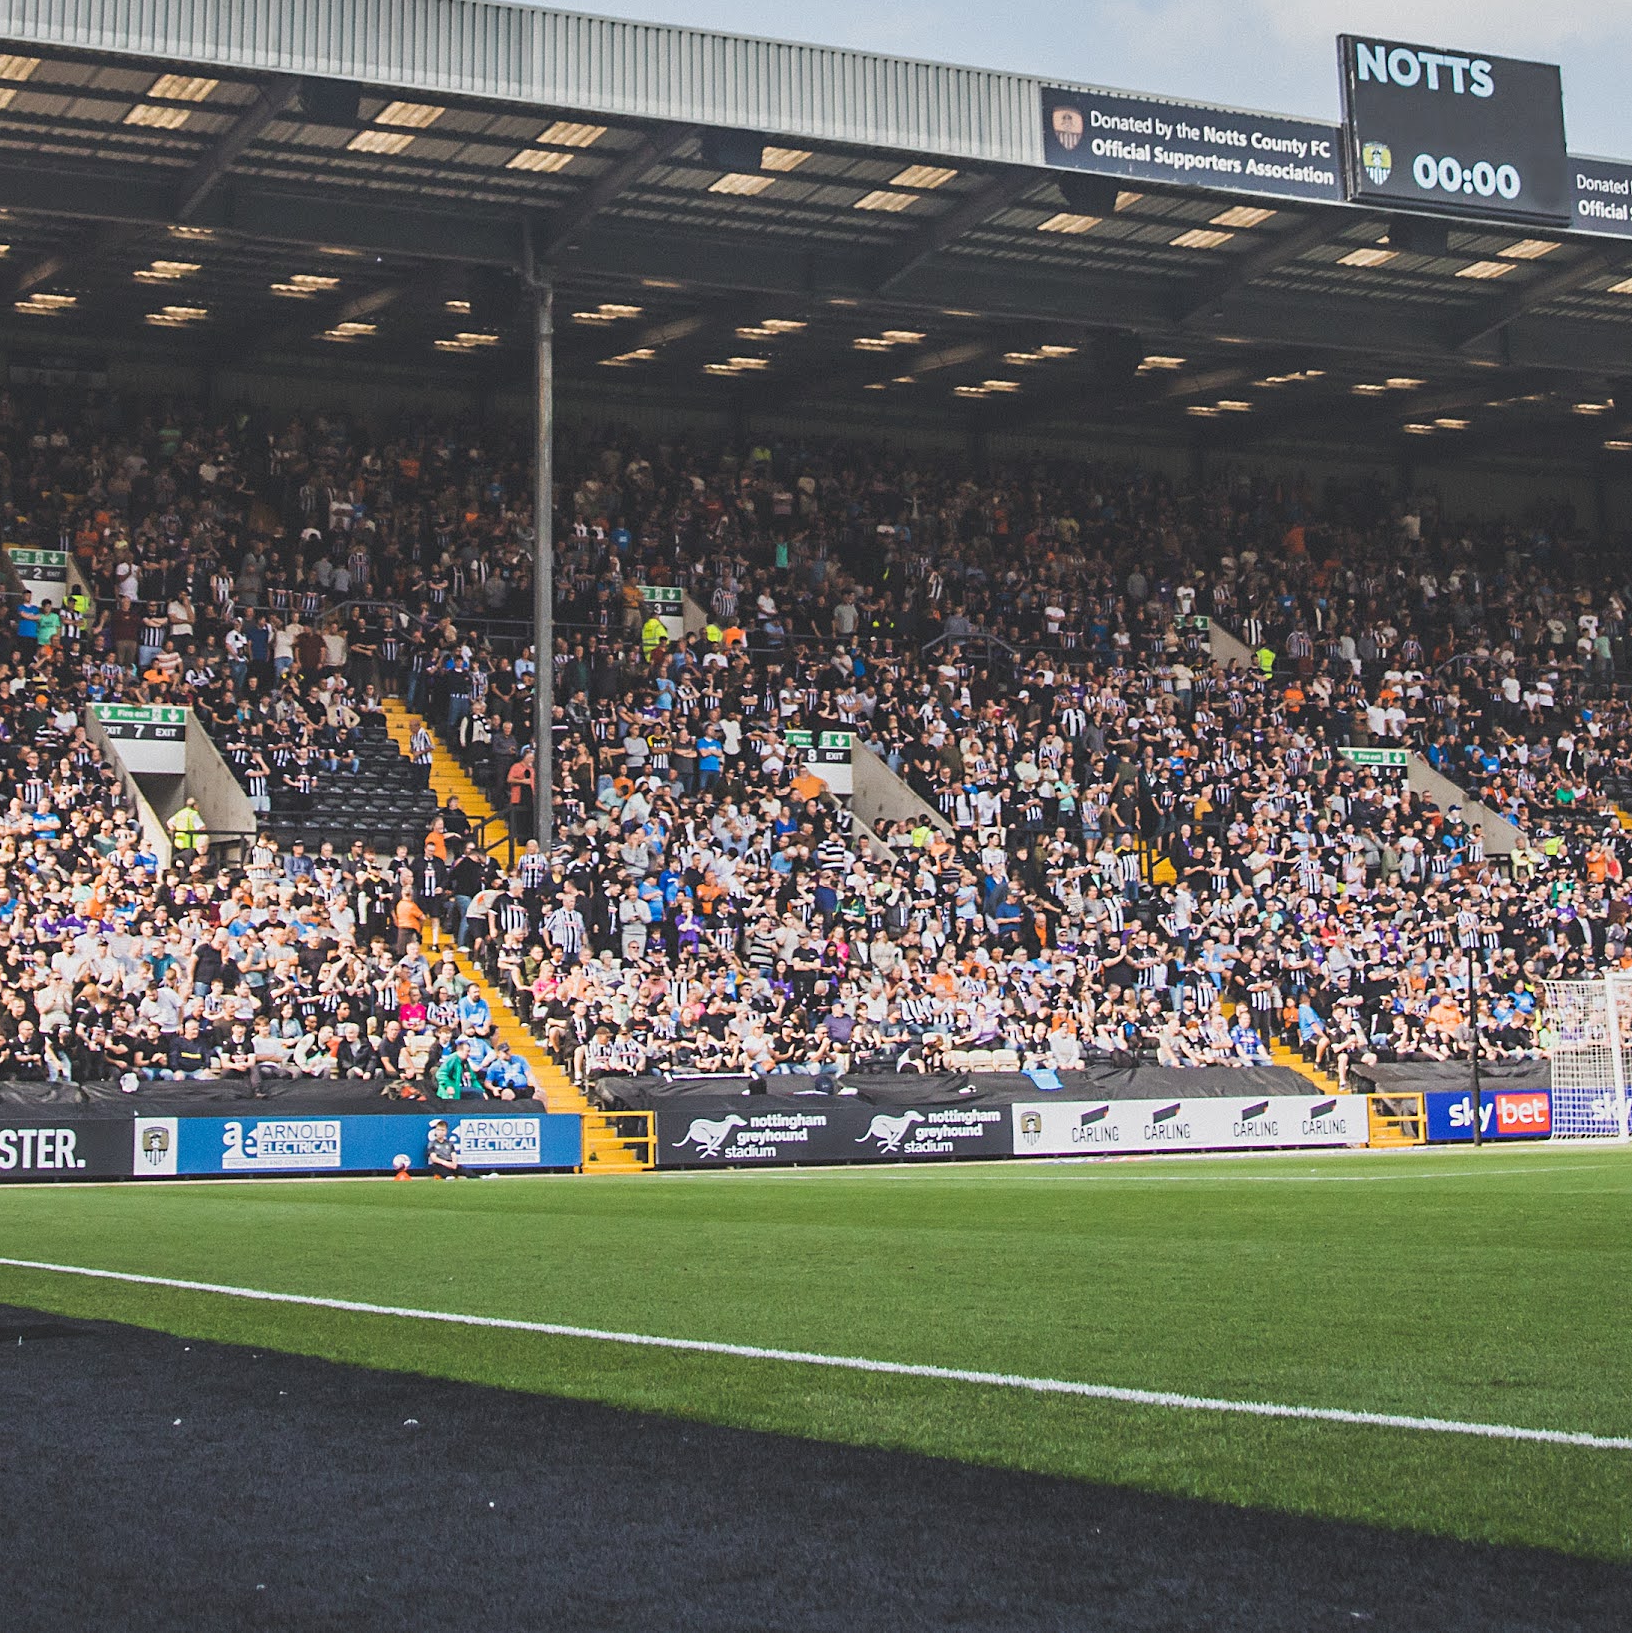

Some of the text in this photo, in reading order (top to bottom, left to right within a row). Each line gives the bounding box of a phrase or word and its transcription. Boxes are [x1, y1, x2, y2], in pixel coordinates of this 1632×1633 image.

[1356, 43, 1495, 98] NOTTS
[1090, 110, 1331, 158] Donated by the Notts County FC
[1091, 139, 1335, 185] Official Supporters Association
[1413, 153, 1521, 200] 00:00
[1576, 174, 1629, 195] Donated
[1578, 200, 1628, 221] Official
[33, 567, 43, 579] 2
[654, 602, 662, 614] 3
[117, 709, 150, 719] Fire exit
[134, 724, 145, 738] 7
[155, 728, 177, 737] EXIT
[793, 735, 807, 743] Fire
[807, 749, 844, 762] 8 EXIT
[1370, 765, 1380, 777] 9
[928, 1109, 1001, 1125] nottingham
[1499, 1097, 1546, 1125] bet
[465, 1122, 535, 1136] ARNOLD
[750, 1113, 827, 1129] nottingham
[1233, 1120, 1279, 1138] CARLING
[1302, 1119, 1346, 1136] CARLING
[262, 1124, 336, 1139] ARNOLD
[736, 1128, 808, 1146] greyhound
[915, 1124, 983, 1141] greyhound
[1072, 1126, 1119, 1144] CARLING
[1144, 1123, 1191, 1141] CARLING
[261, 1140, 337, 1154] ELECTRICAL
[464, 1138, 536, 1150] ELECTRICAL
[724, 1143, 777, 1159] stadium
[904, 1139, 953, 1154] stadium
